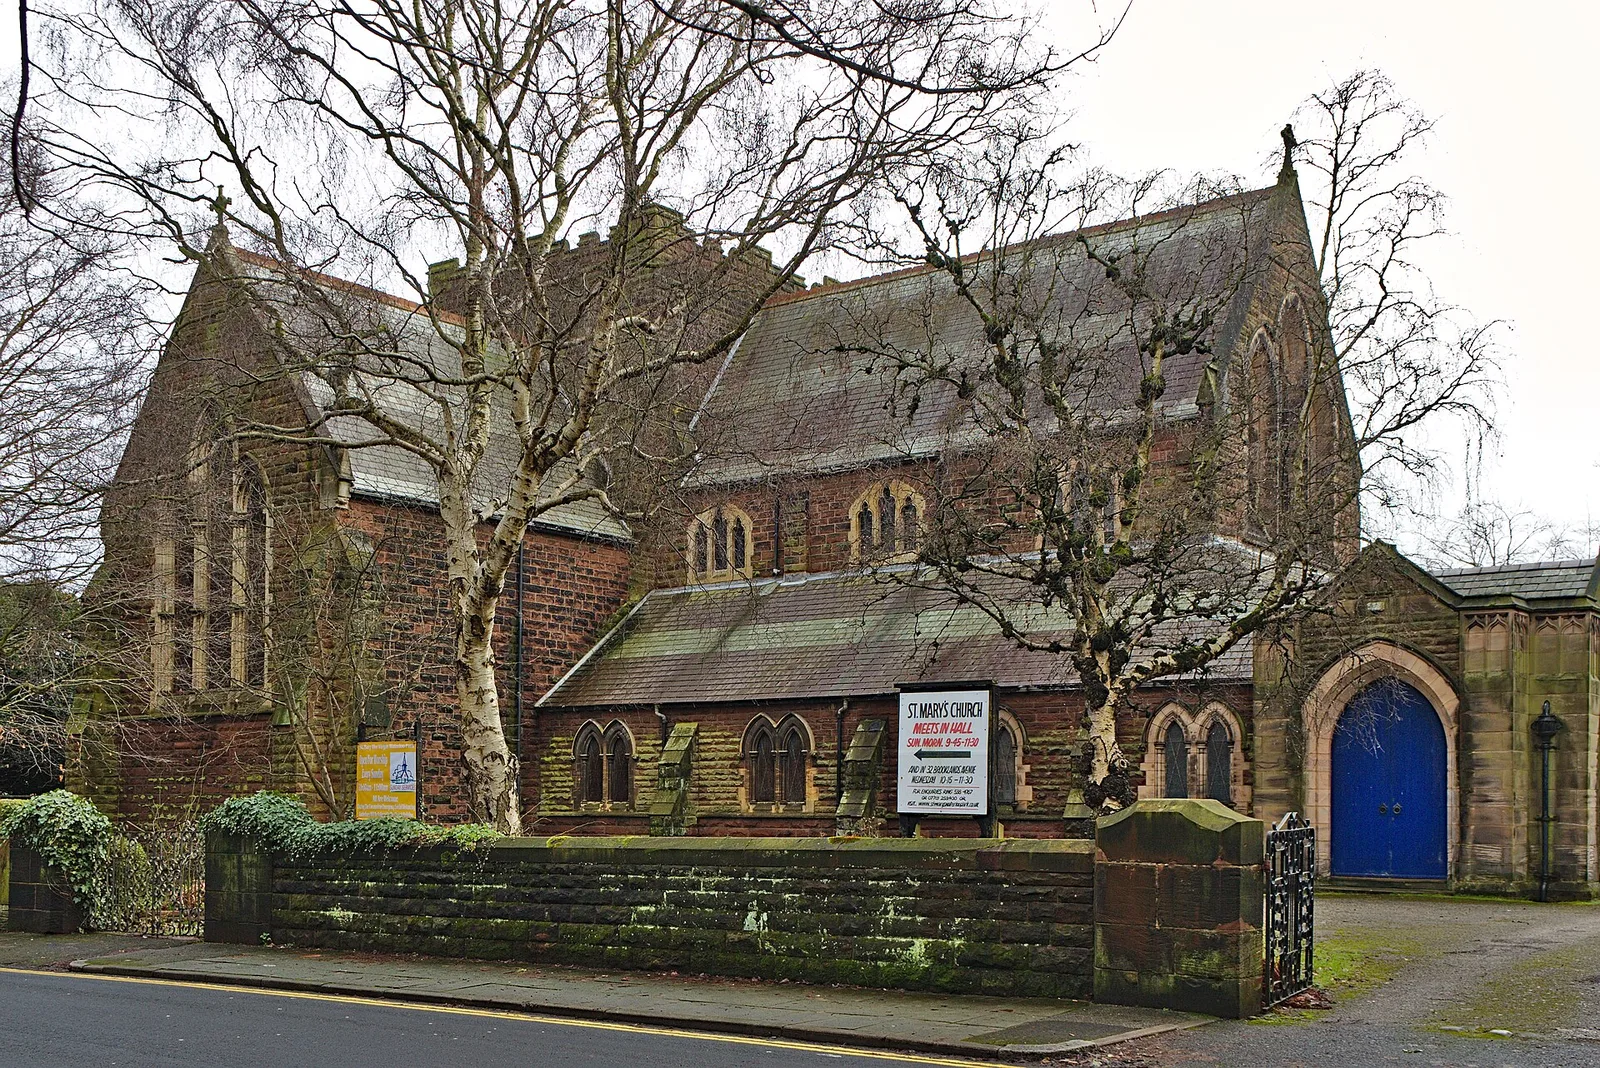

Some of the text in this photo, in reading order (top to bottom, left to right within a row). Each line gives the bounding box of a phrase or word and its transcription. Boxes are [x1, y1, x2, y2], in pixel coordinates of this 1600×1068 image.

[908, 700, 983, 718] ST. MARY'S CHURCH
[913, 722, 973, 734] MEETS IN HALL
[907, 738, 921, 747] SUN.
[922, 738, 944, 747] MORN.
[908, 765, 920, 774] AND
[920, 765, 926, 774] IN
